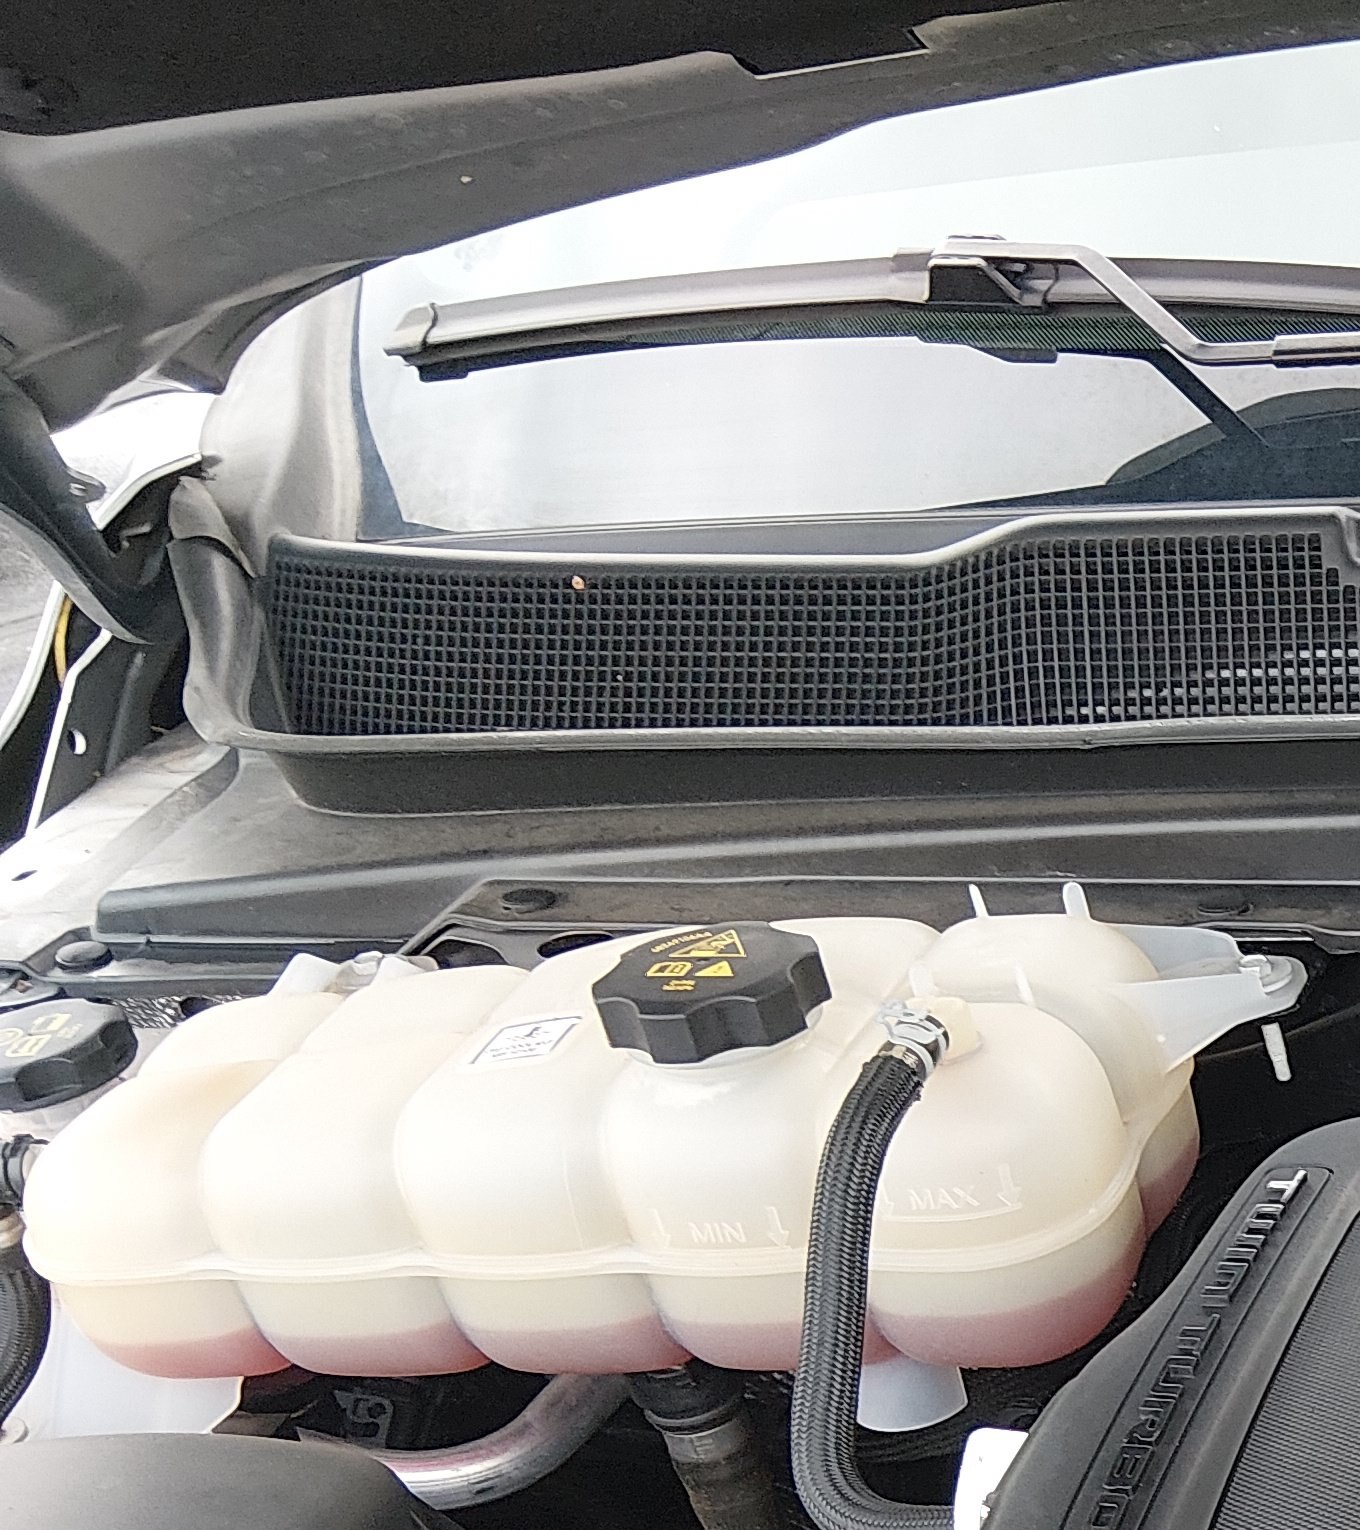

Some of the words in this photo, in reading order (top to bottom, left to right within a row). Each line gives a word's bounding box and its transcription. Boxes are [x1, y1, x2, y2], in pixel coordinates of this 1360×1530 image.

[908, 1186, 982, 1211] MAX
[687, 1221, 748, 1244] MIN
[1199, 1168, 1309, 1308] TWIN
